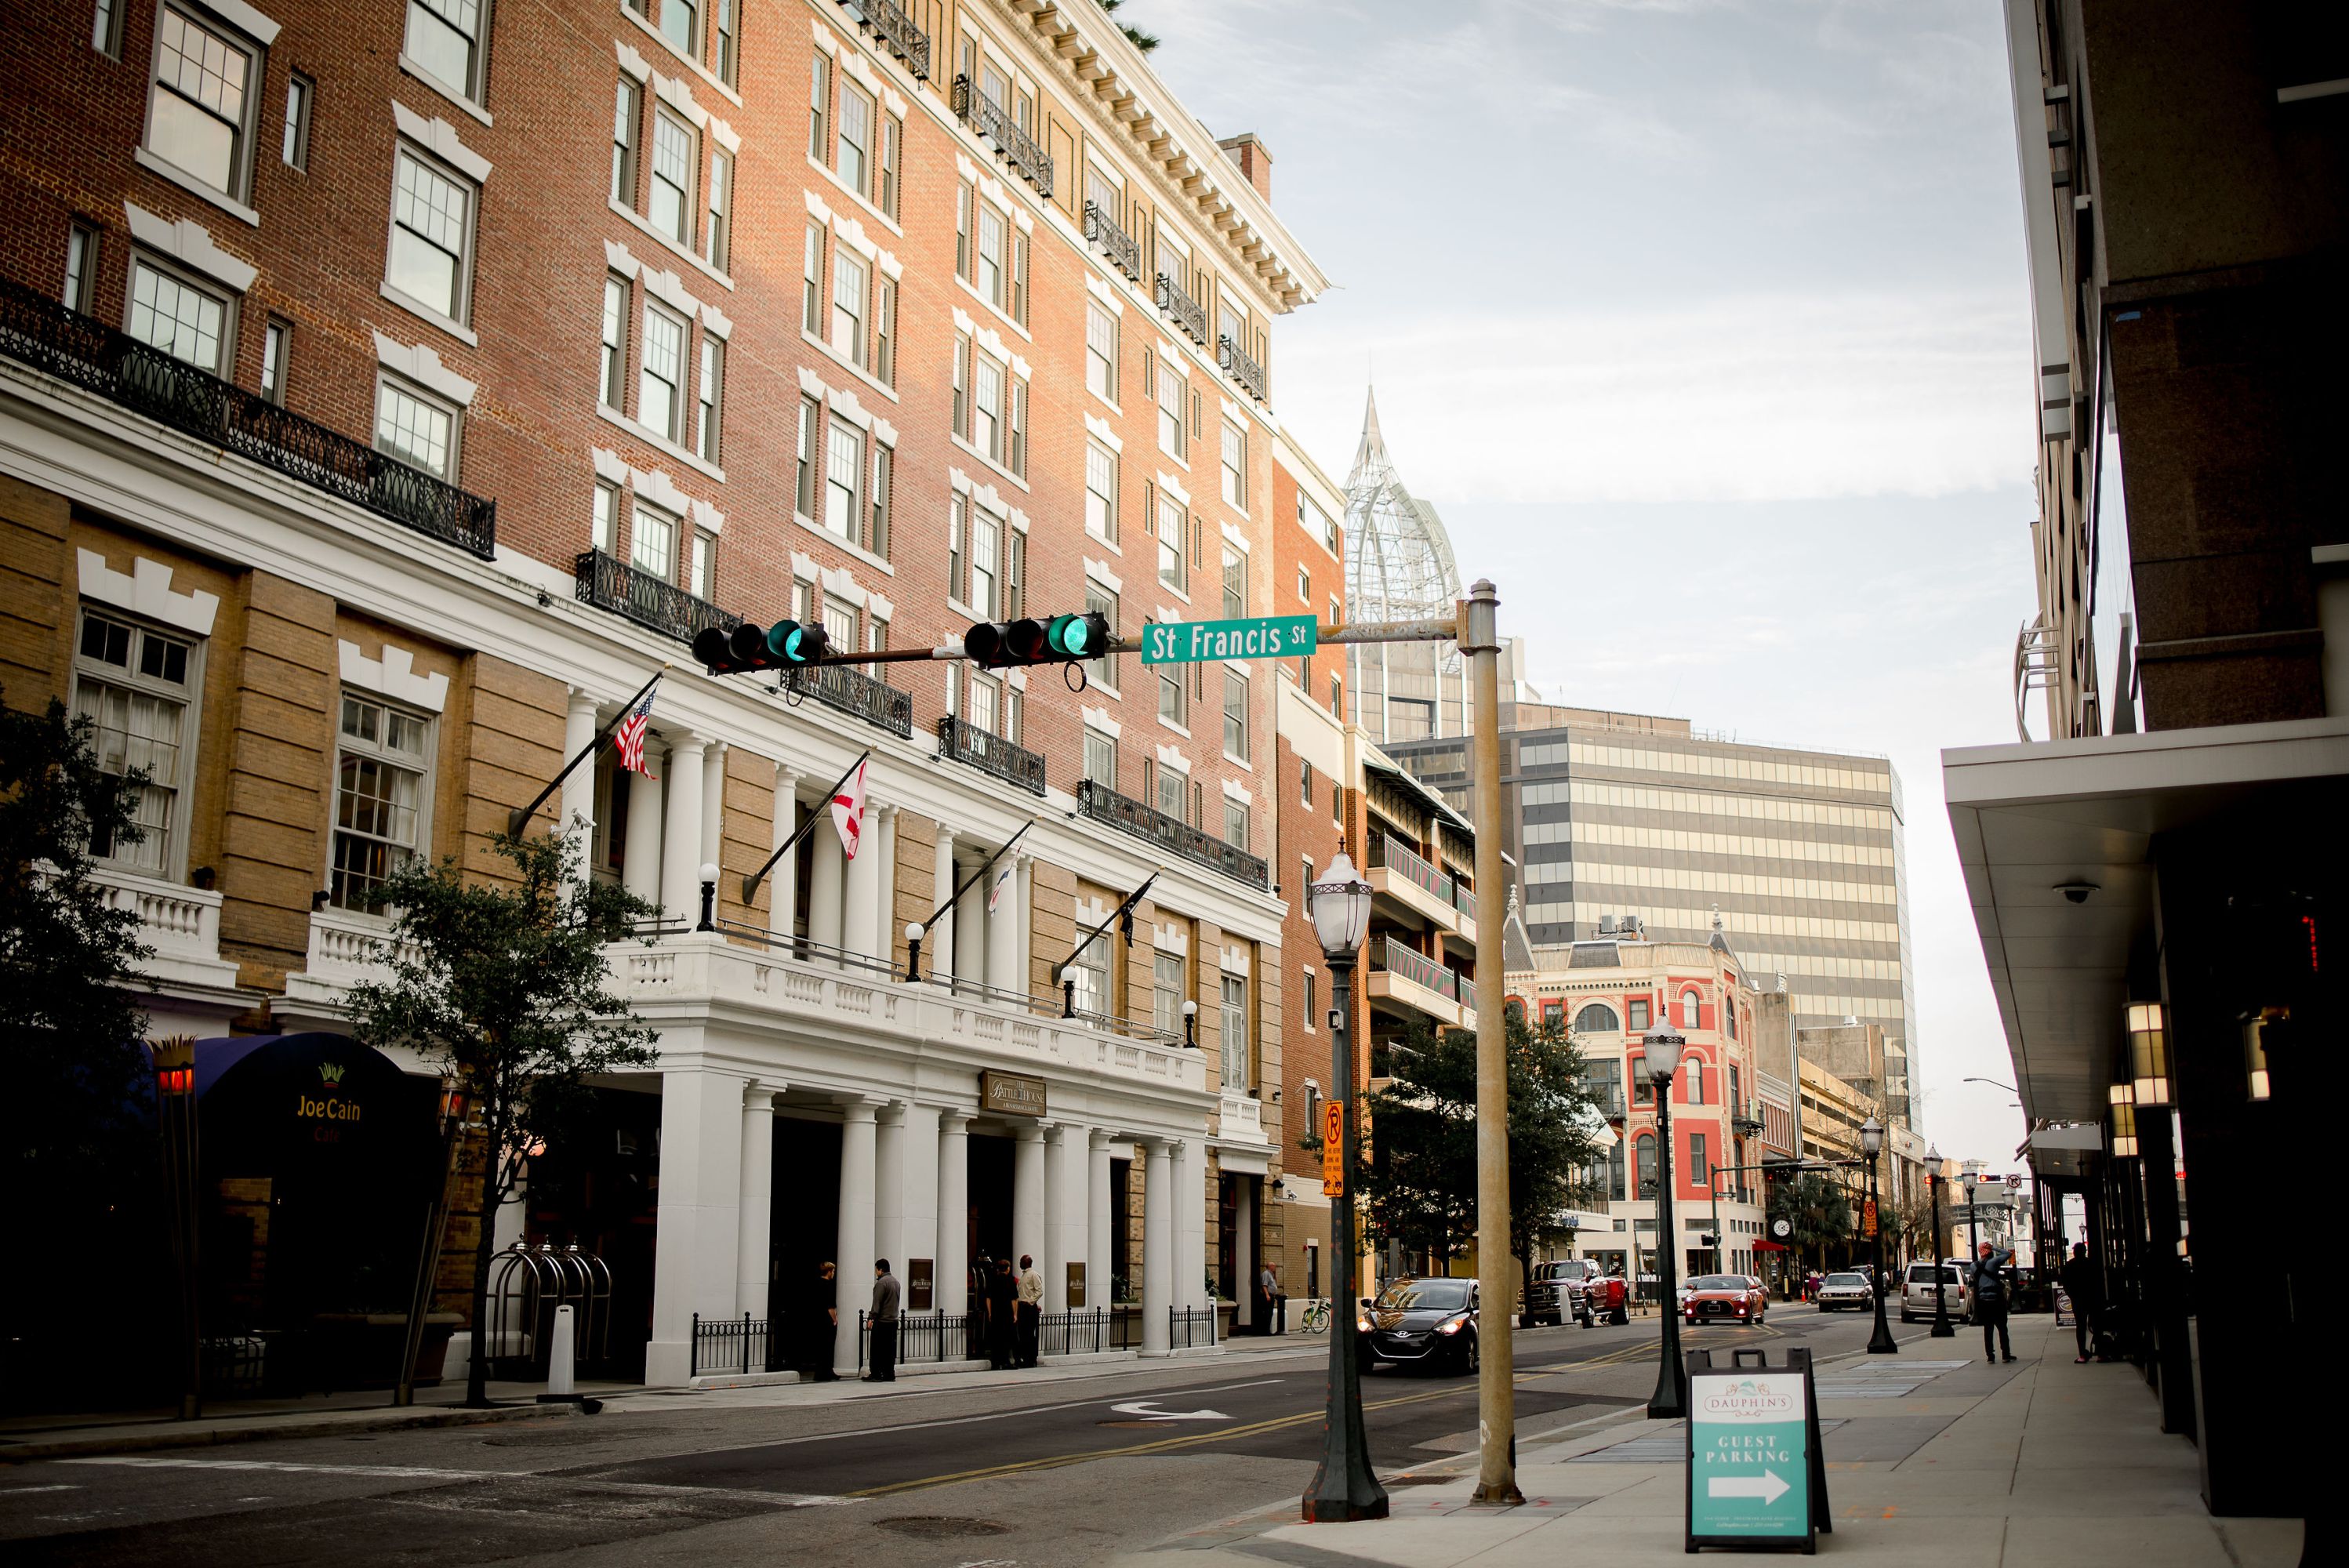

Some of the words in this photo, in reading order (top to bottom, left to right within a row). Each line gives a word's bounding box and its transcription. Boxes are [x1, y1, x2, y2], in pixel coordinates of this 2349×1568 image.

[1151, 627, 1176, 660] St
[1191, 621, 1281, 658] Francis
[1291, 625, 1306, 644] St
[1712, 1398, 1787, 1408] DAUPHIN'S
[1718, 1436, 1777, 1448] GUEST
[1706, 1450, 1789, 1463] PARKING
